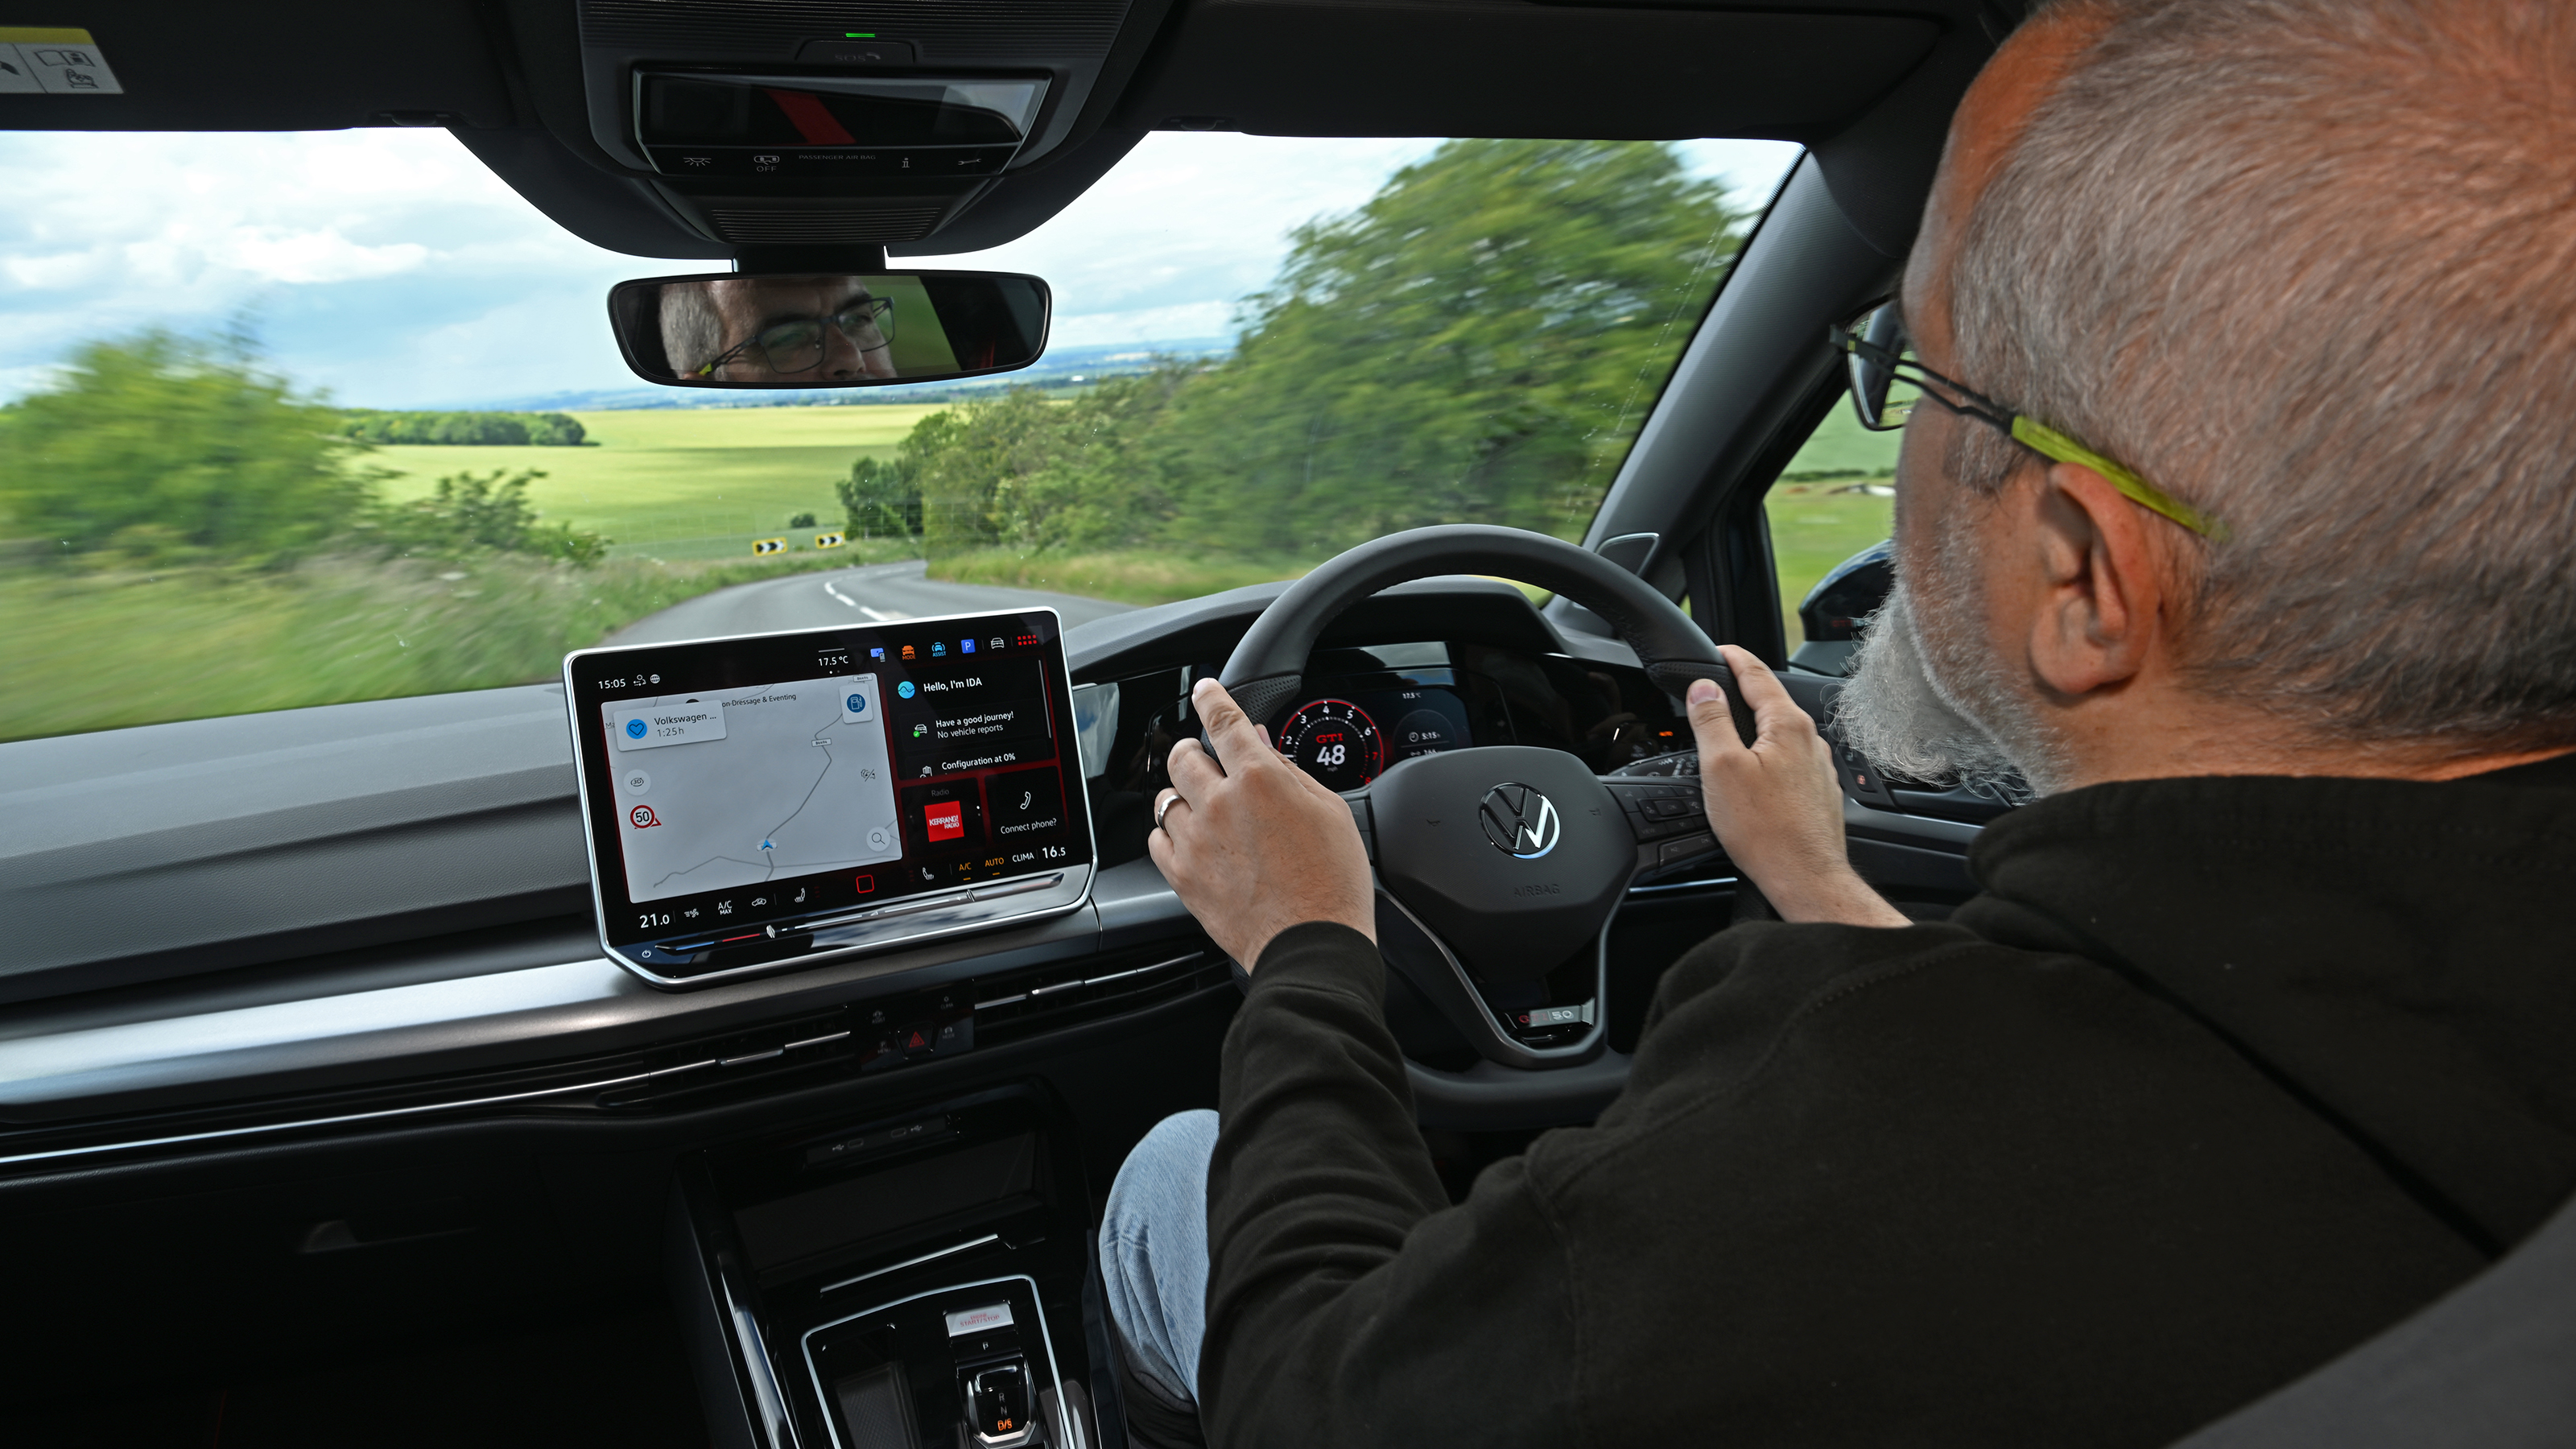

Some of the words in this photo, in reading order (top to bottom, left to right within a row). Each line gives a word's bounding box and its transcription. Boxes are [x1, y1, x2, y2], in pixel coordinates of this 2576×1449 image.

[835, 54, 866, 62] SOS
[818, 657, 837, 667] 17.5
[839, 655, 848, 664] °C
[598, 679, 625, 689] 15:05
[923, 682, 948, 692] Hello,
[950, 680, 964, 689] I'm
[966, 678, 982, 687] IDA
[732, 698, 761, 706] Dressage
[770, 694, 796, 702] Eventing
[1323, 705, 1330, 714] 4
[1347, 710, 1354, 719] 5
[654, 713, 708, 725] Volkswagen
[935, 719, 955, 728] Have
[964, 715, 982, 726] good
[984, 711, 1013, 724] journey!
[1300, 715, 1307, 724] 3
[937, 731, 949, 739] No
[951, 727, 976, 737] vehicle
[978, 724, 1004, 734] reports
[1364, 727, 1372, 736] 6
[1286, 736, 1293, 745] 2
[1315, 733, 1344, 744] GTI
[1316, 744, 1346, 766] 48
[1372, 751, 1378, 761] 7
[942, 757, 993, 770] Configuration
[994, 755, 1002, 763] at
[1003, 753, 1016, 762] 0%
[931, 788, 950, 797] Radio
[635, 811, 650, 823] 50
[929, 815, 959, 827] KERRANG!
[1001, 823, 1030, 835] Connect
[1031, 818, 1057, 831] phone?
[1012, 852, 1034, 863] CLIMA
[1042, 846, 1066, 859] 16.5
[959, 862, 972, 872] A/C
[985, 857, 1005, 867] AUTO
[1513, 883, 1560, 898] AIRBAG
[718, 900, 732, 910] A/C
[639, 913, 670, 928] 21.0
[1551, 1009, 1574, 1021] 50
[960, 1315, 1000, 1327] START/STOP
[998, 1392, 1005, 1403] R
[1001, 1406, 1008, 1416] N
